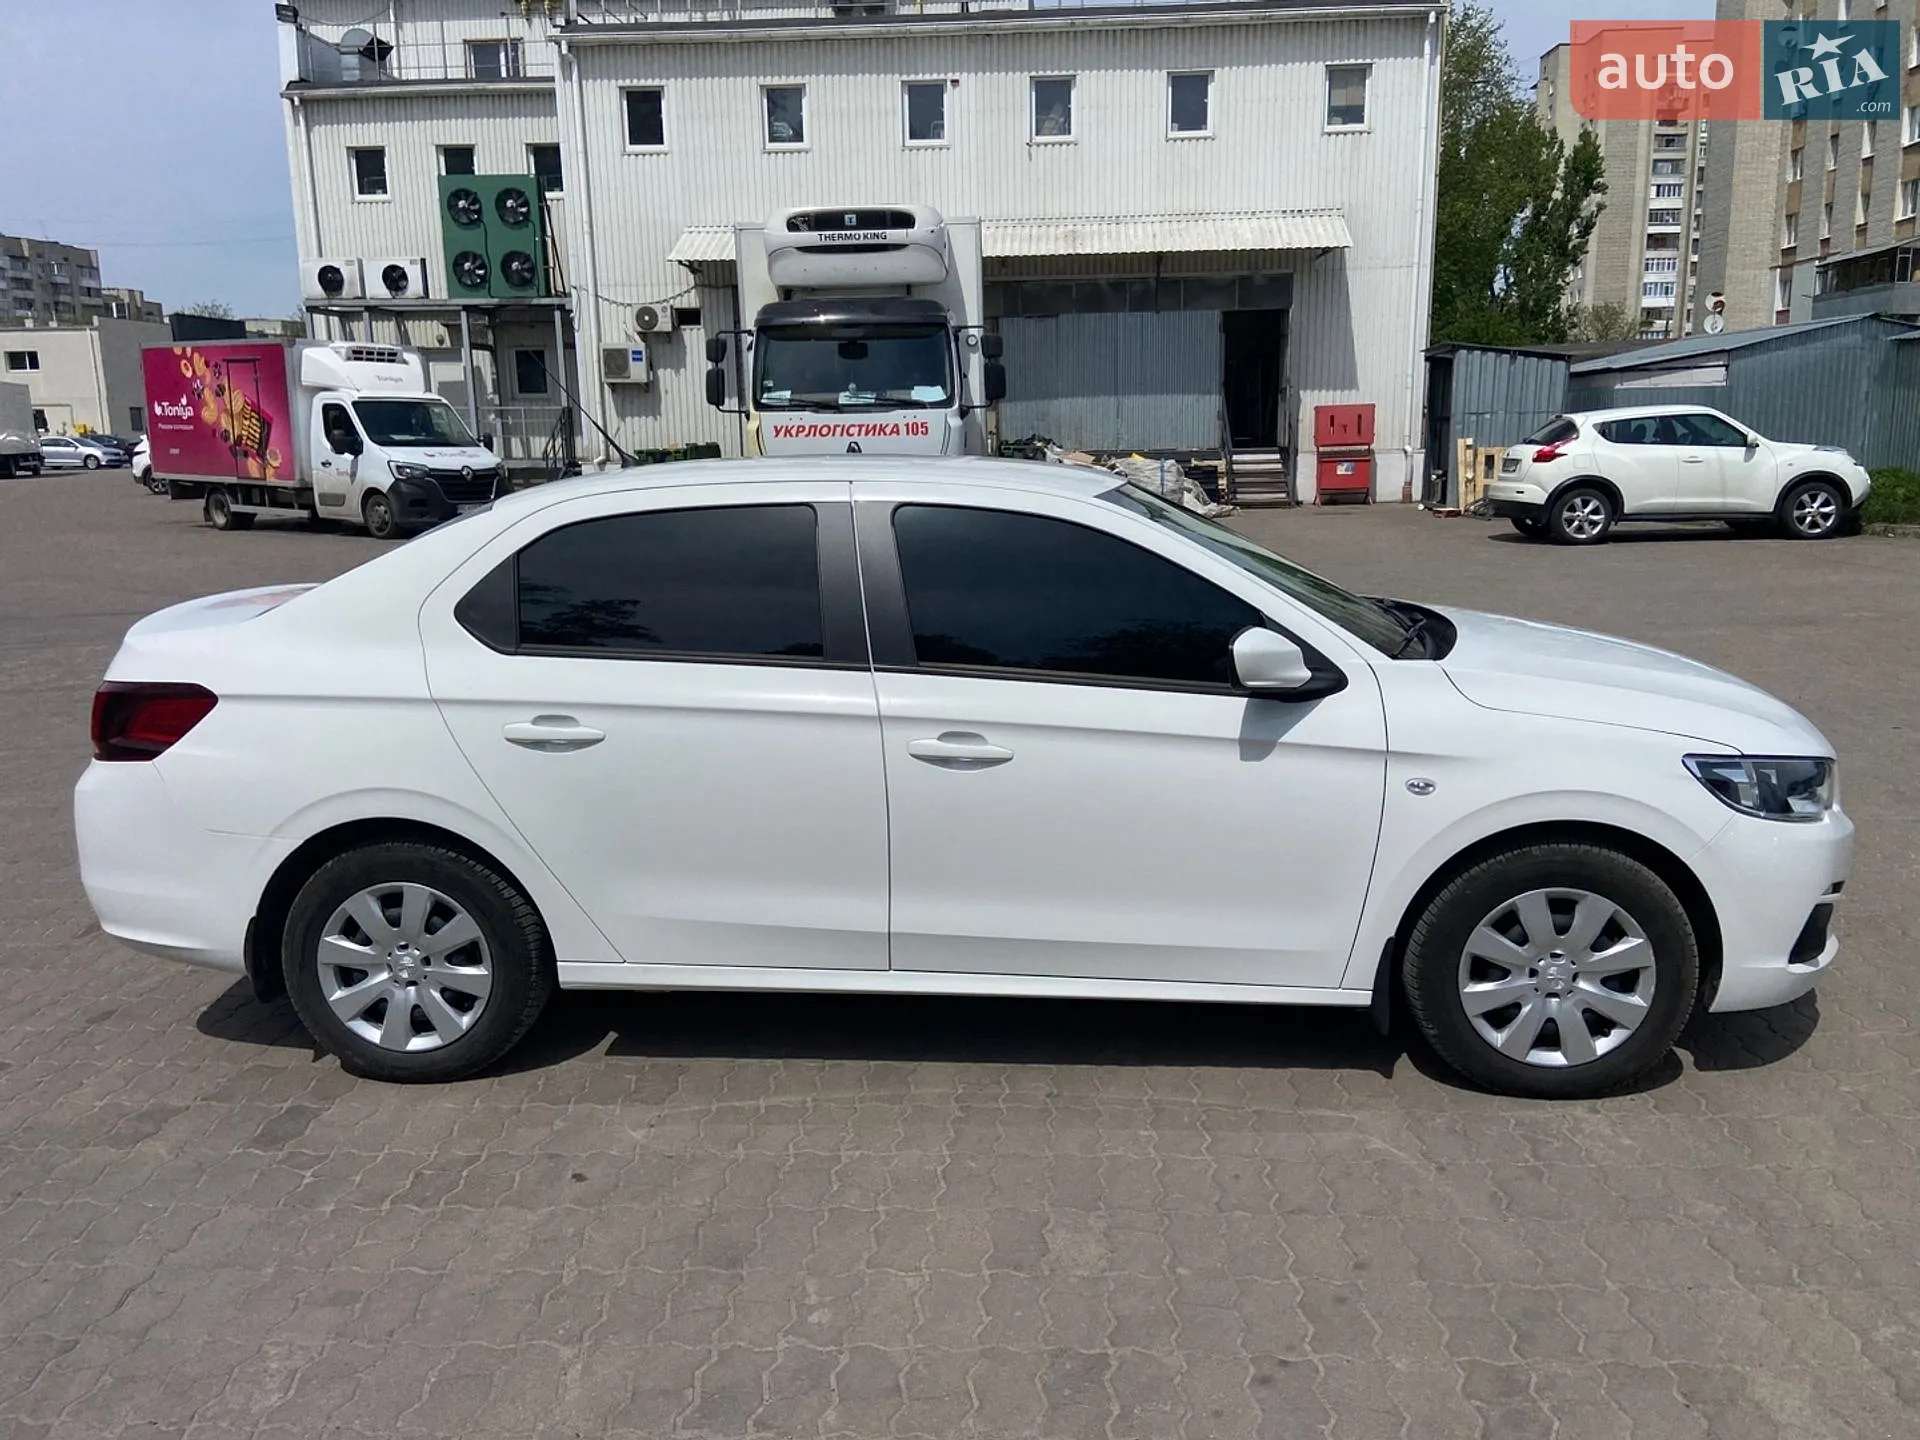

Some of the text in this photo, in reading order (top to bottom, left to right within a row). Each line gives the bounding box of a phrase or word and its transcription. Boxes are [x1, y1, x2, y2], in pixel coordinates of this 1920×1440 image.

[818, 231, 888, 242] THERMO KING
[773, 421, 929, 438] УКРЛОГІСТИКА 105
